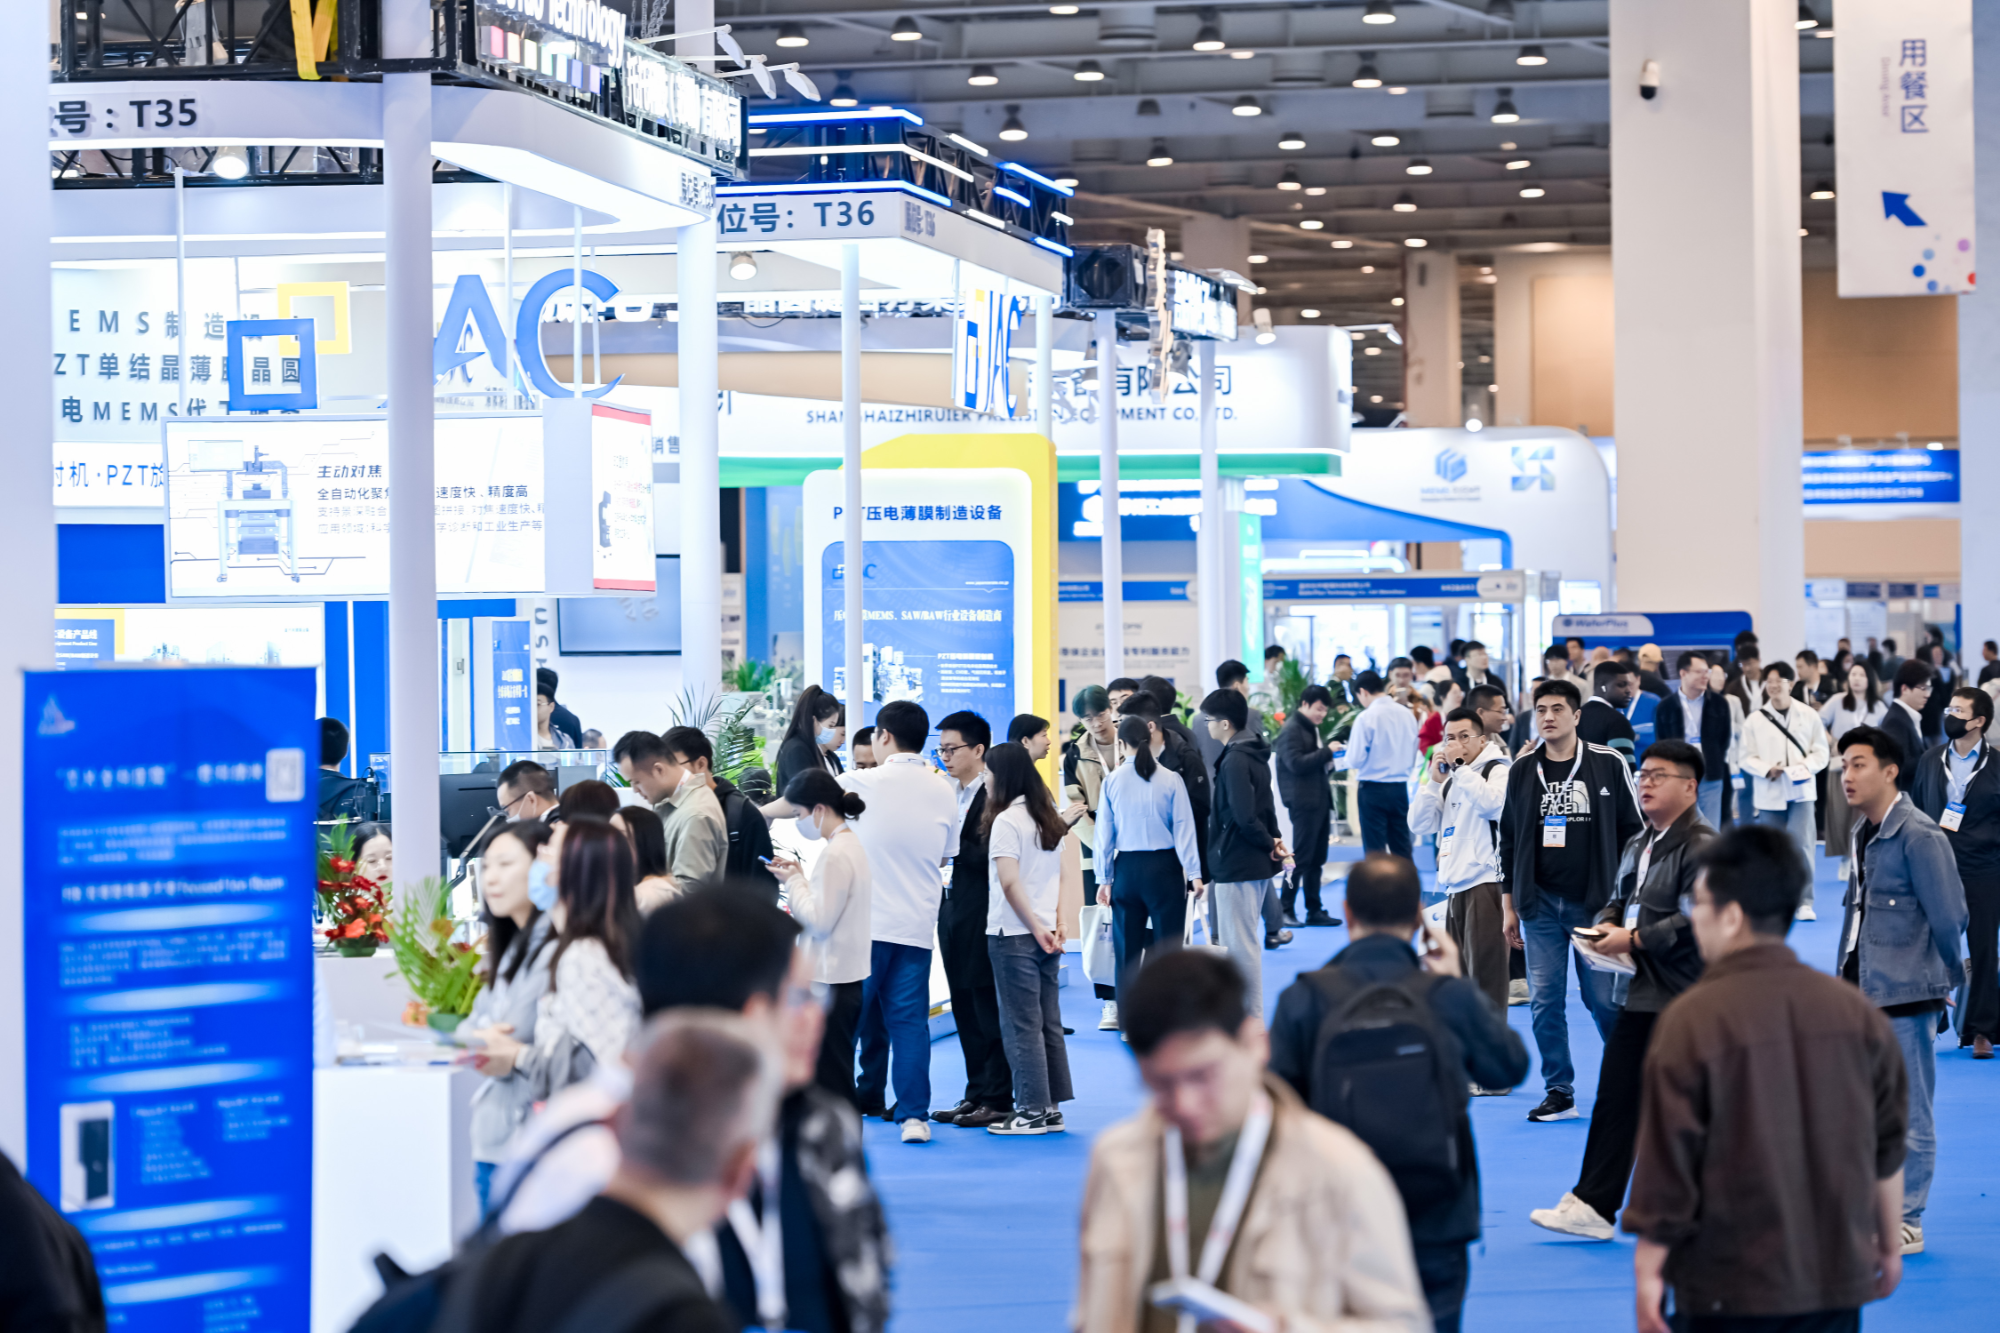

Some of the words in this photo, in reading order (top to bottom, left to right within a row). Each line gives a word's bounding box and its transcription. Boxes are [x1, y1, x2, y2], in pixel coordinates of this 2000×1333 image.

[1900, 39, 1929, 133] 用餐区
[317, 465, 382, 478] 主动对焦
[833, 505, 1002, 521] P压电薄膜制造设备
[1547, 781, 1573, 793] THE
[1540, 803, 1573, 817] FACE
